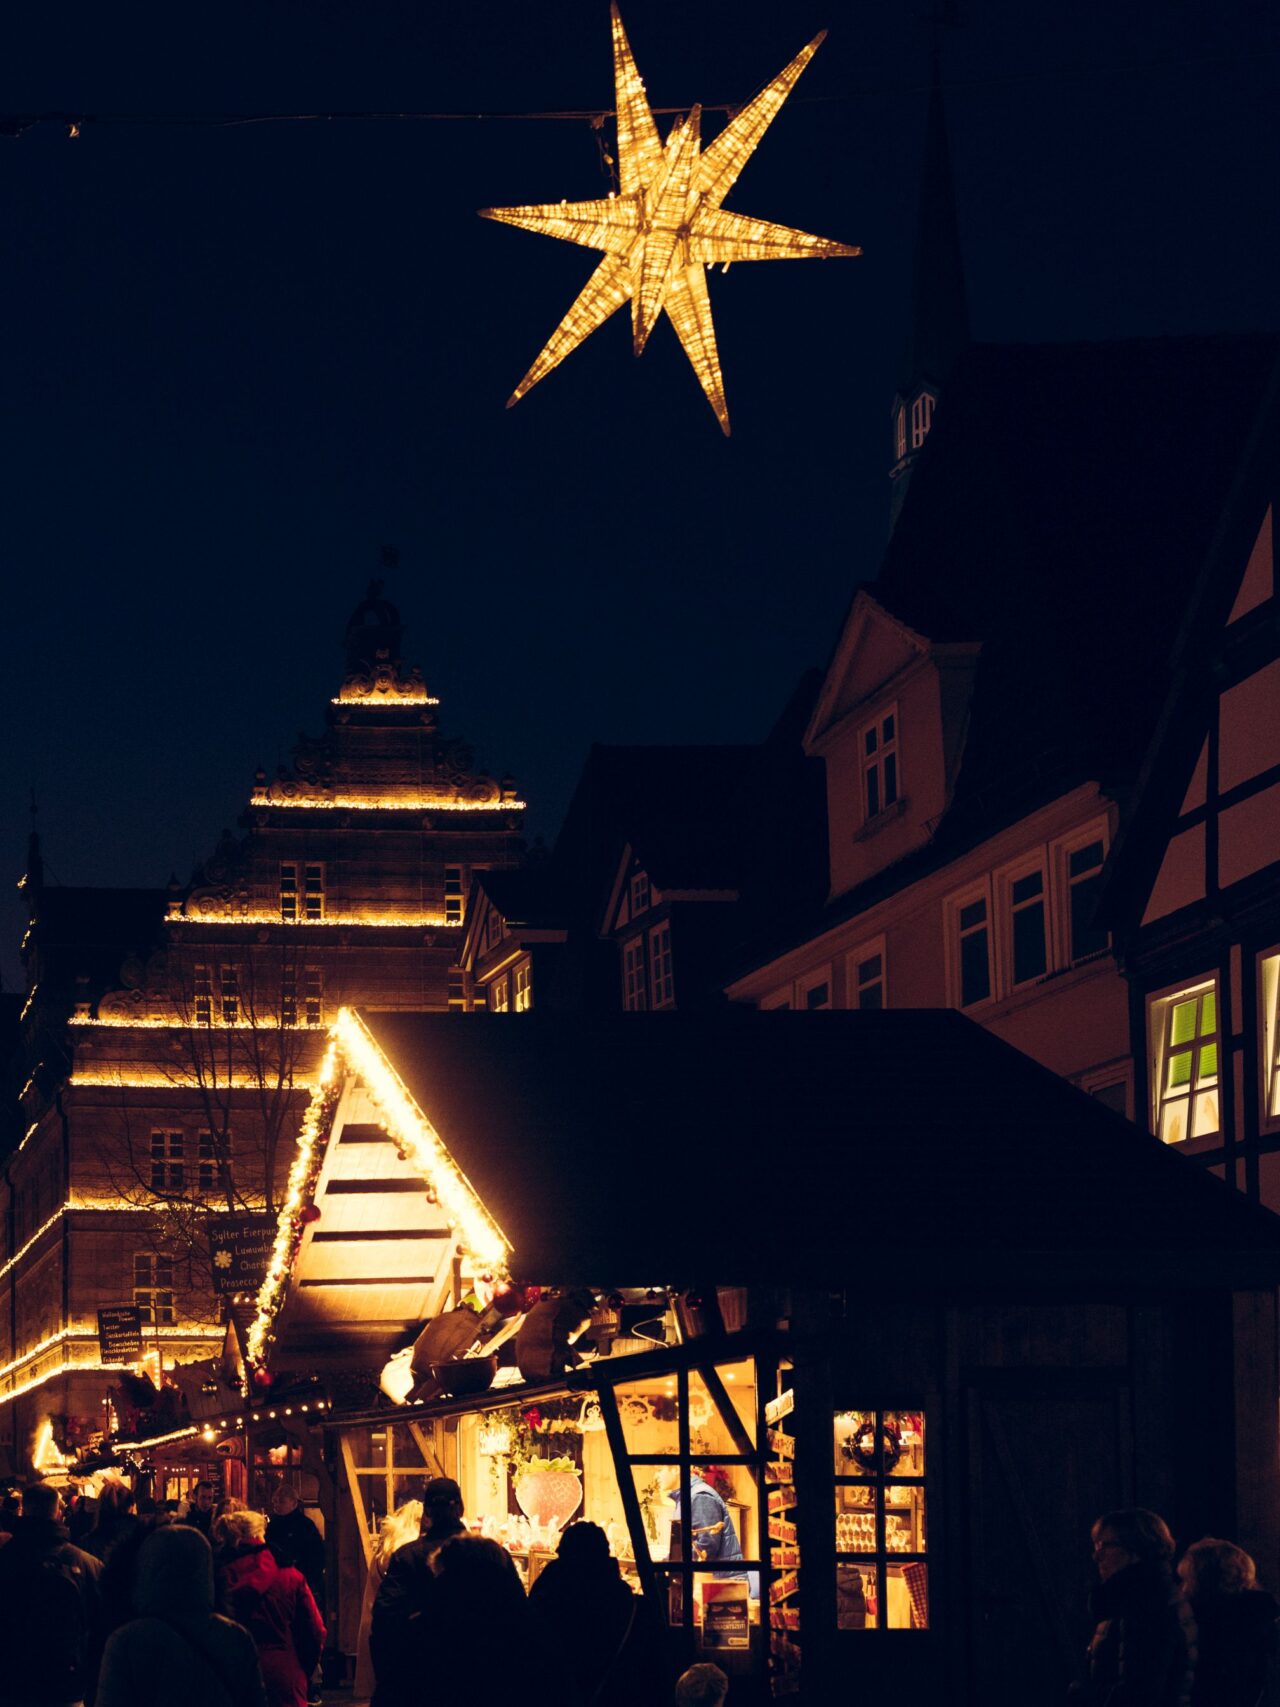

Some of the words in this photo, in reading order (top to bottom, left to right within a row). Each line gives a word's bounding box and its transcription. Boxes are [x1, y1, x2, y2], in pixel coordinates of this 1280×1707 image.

[212, 1229, 240, 1244] Sylter
[243, 1227, 279, 1240] Eierpun
[240, 1258, 266, 1271] Chard
[221, 1278, 258, 1288] Prosecco
